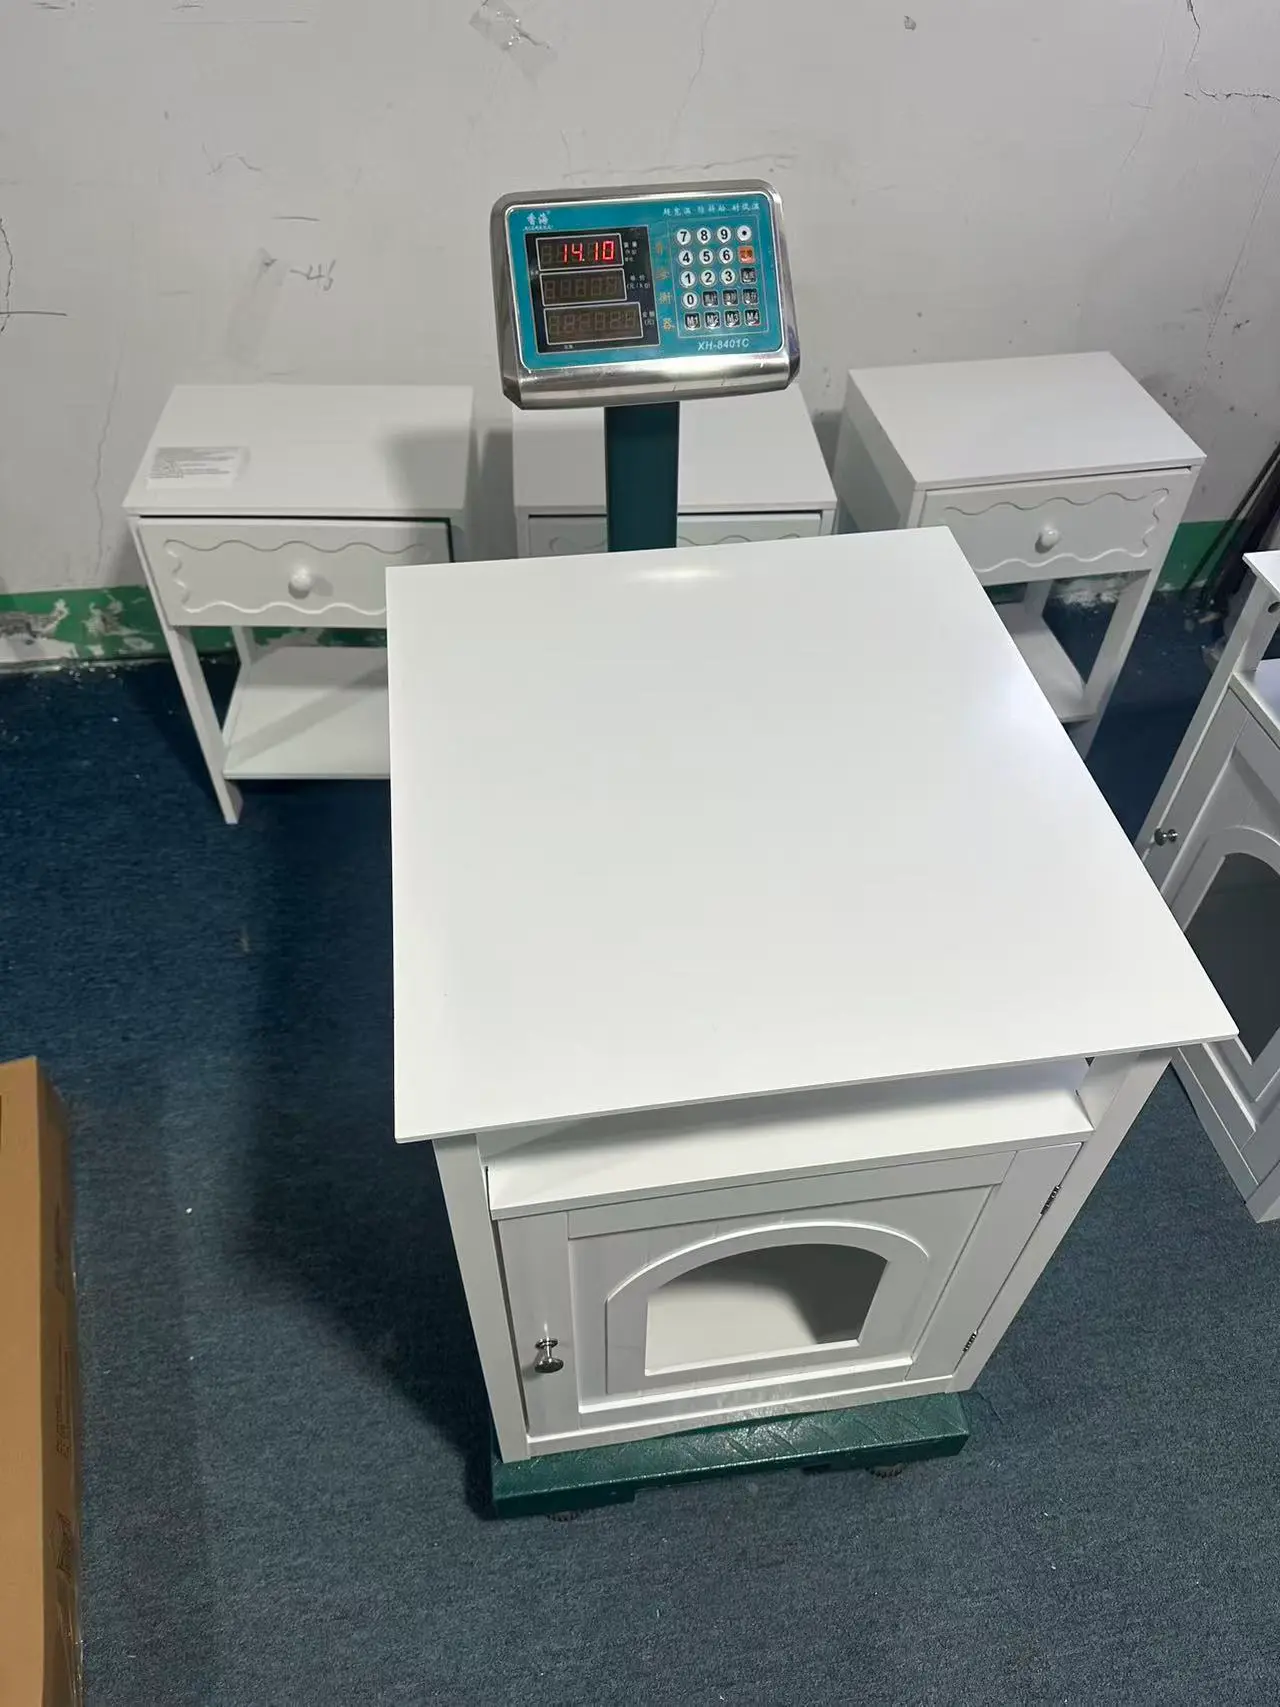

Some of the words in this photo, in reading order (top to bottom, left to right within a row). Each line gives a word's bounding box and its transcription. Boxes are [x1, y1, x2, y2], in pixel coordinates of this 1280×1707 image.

[680, 231, 688, 242] 7
[700, 229, 708, 241] 8
[720, 228, 728, 240] 9
[562, 240, 615, 263] 14.10
[682, 252, 690, 263] 4
[703, 251, 711, 262] 5
[723, 249, 730, 261] 6
[704, 272, 712, 283] 2
[725, 270, 733, 282] 3
[686, 294, 694, 305] 0
[686, 316, 699, 325] M1
[706, 314, 719, 324] M2
[726, 313, 739, 323] M3
[746, 312, 758, 321] M4
[697, 338, 750, 351] XH-8401C
